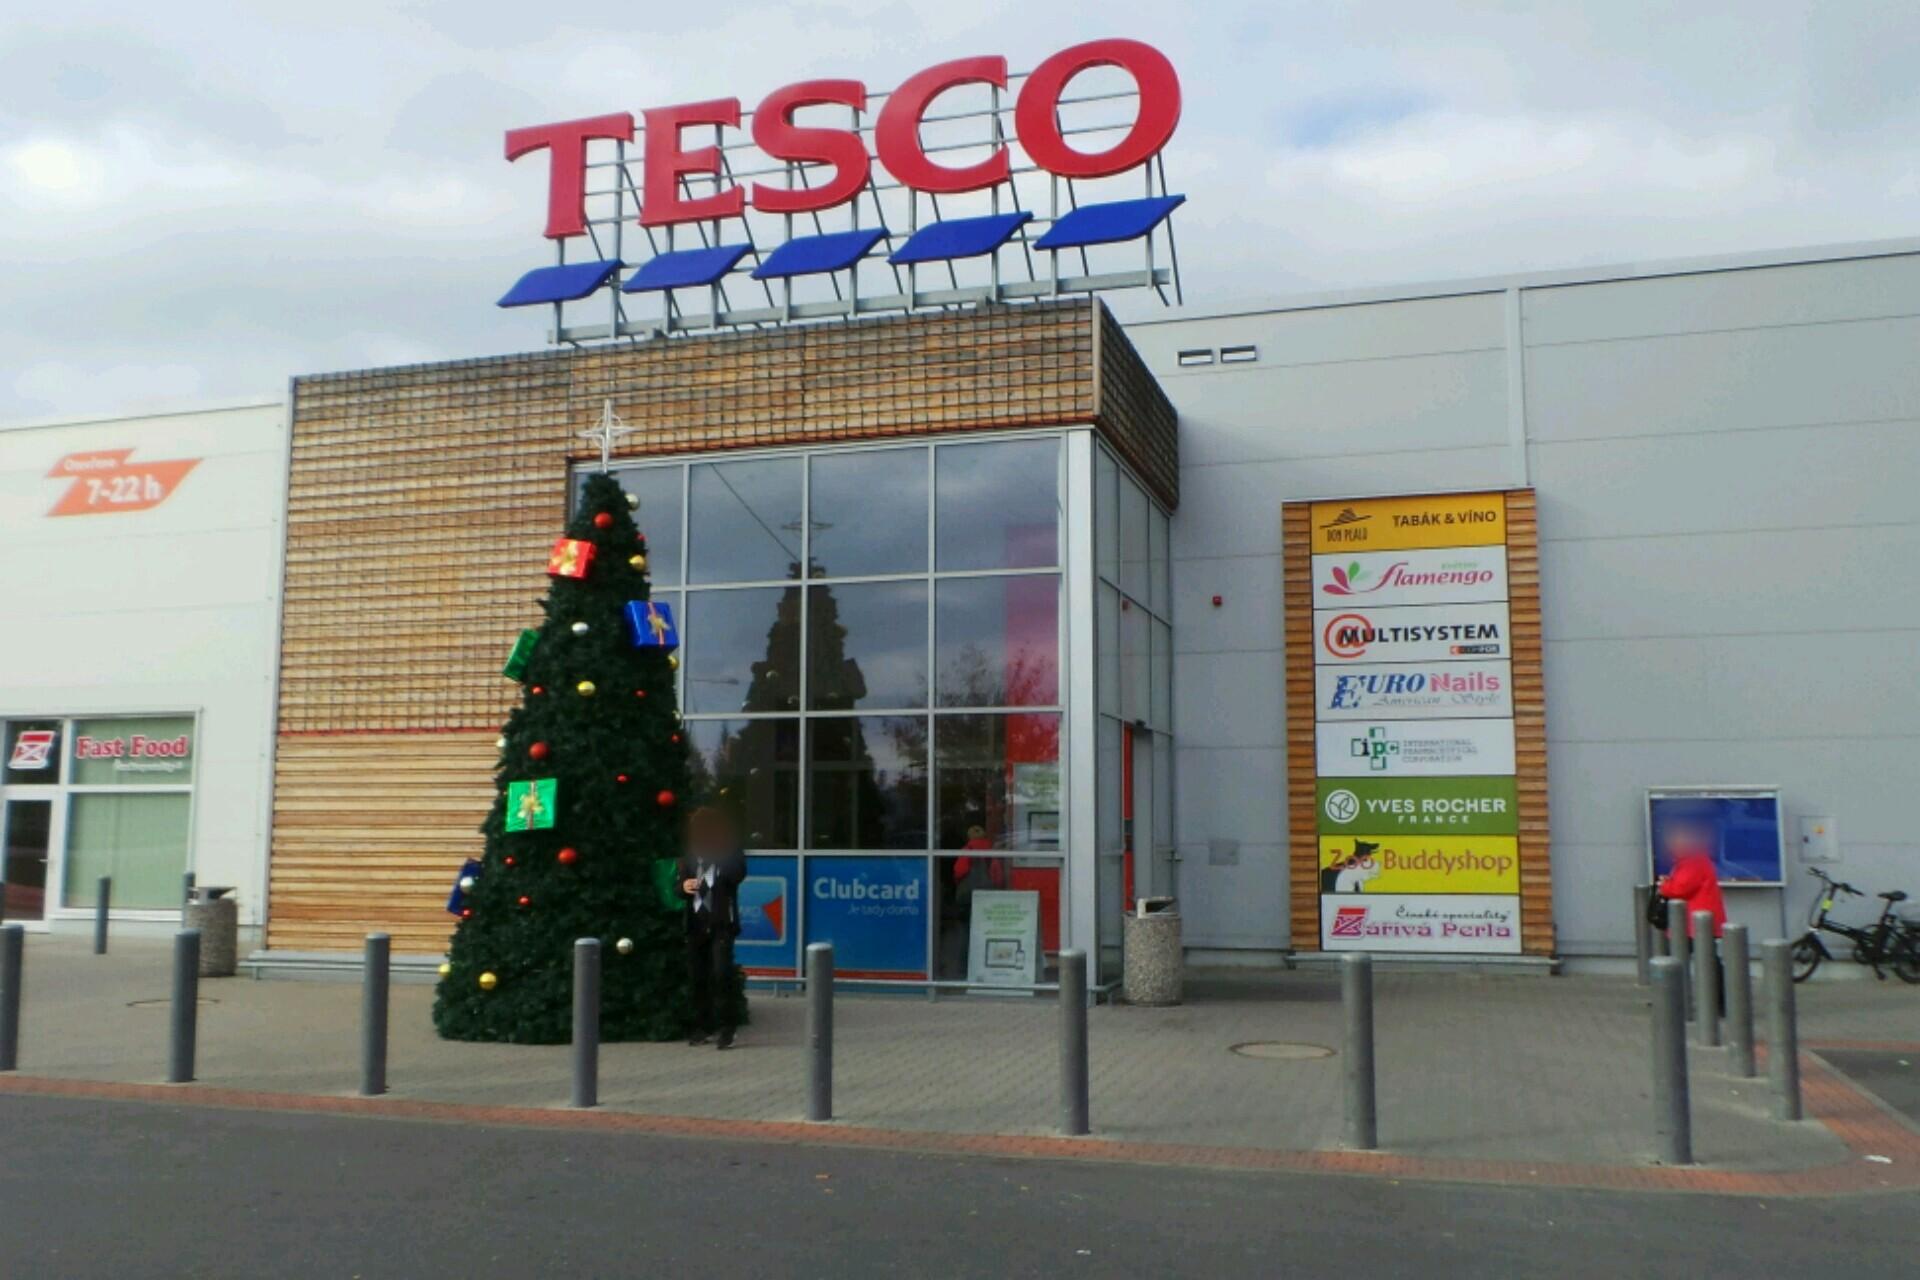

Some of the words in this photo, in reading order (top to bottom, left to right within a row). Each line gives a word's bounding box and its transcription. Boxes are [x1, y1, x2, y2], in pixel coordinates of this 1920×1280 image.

[505, 38, 1181, 239] TESCO
[86, 476, 140, 504] 7-22
[144, 474, 162, 501] h
[1392, 511, 1441, 528] TABÁK
[1444, 511, 1455, 524] &
[1458, 508, 1497, 523] VÍNO
[1431, 672, 1501, 692] Nails
[76, 736, 125, 759] Fast
[129, 734, 189, 758] Food
[1365, 799, 1416, 814] YVES
[1422, 798, 1507, 813] ROCHER
[1398, 815, 1471, 825] FRANCE
[1329, 849, 1375, 870] Zoo
[1384, 849, 1513, 875] Buddyshop
[813, 877, 920, 900] Clubcard
[1441, 922, 1512, 939] Perla
